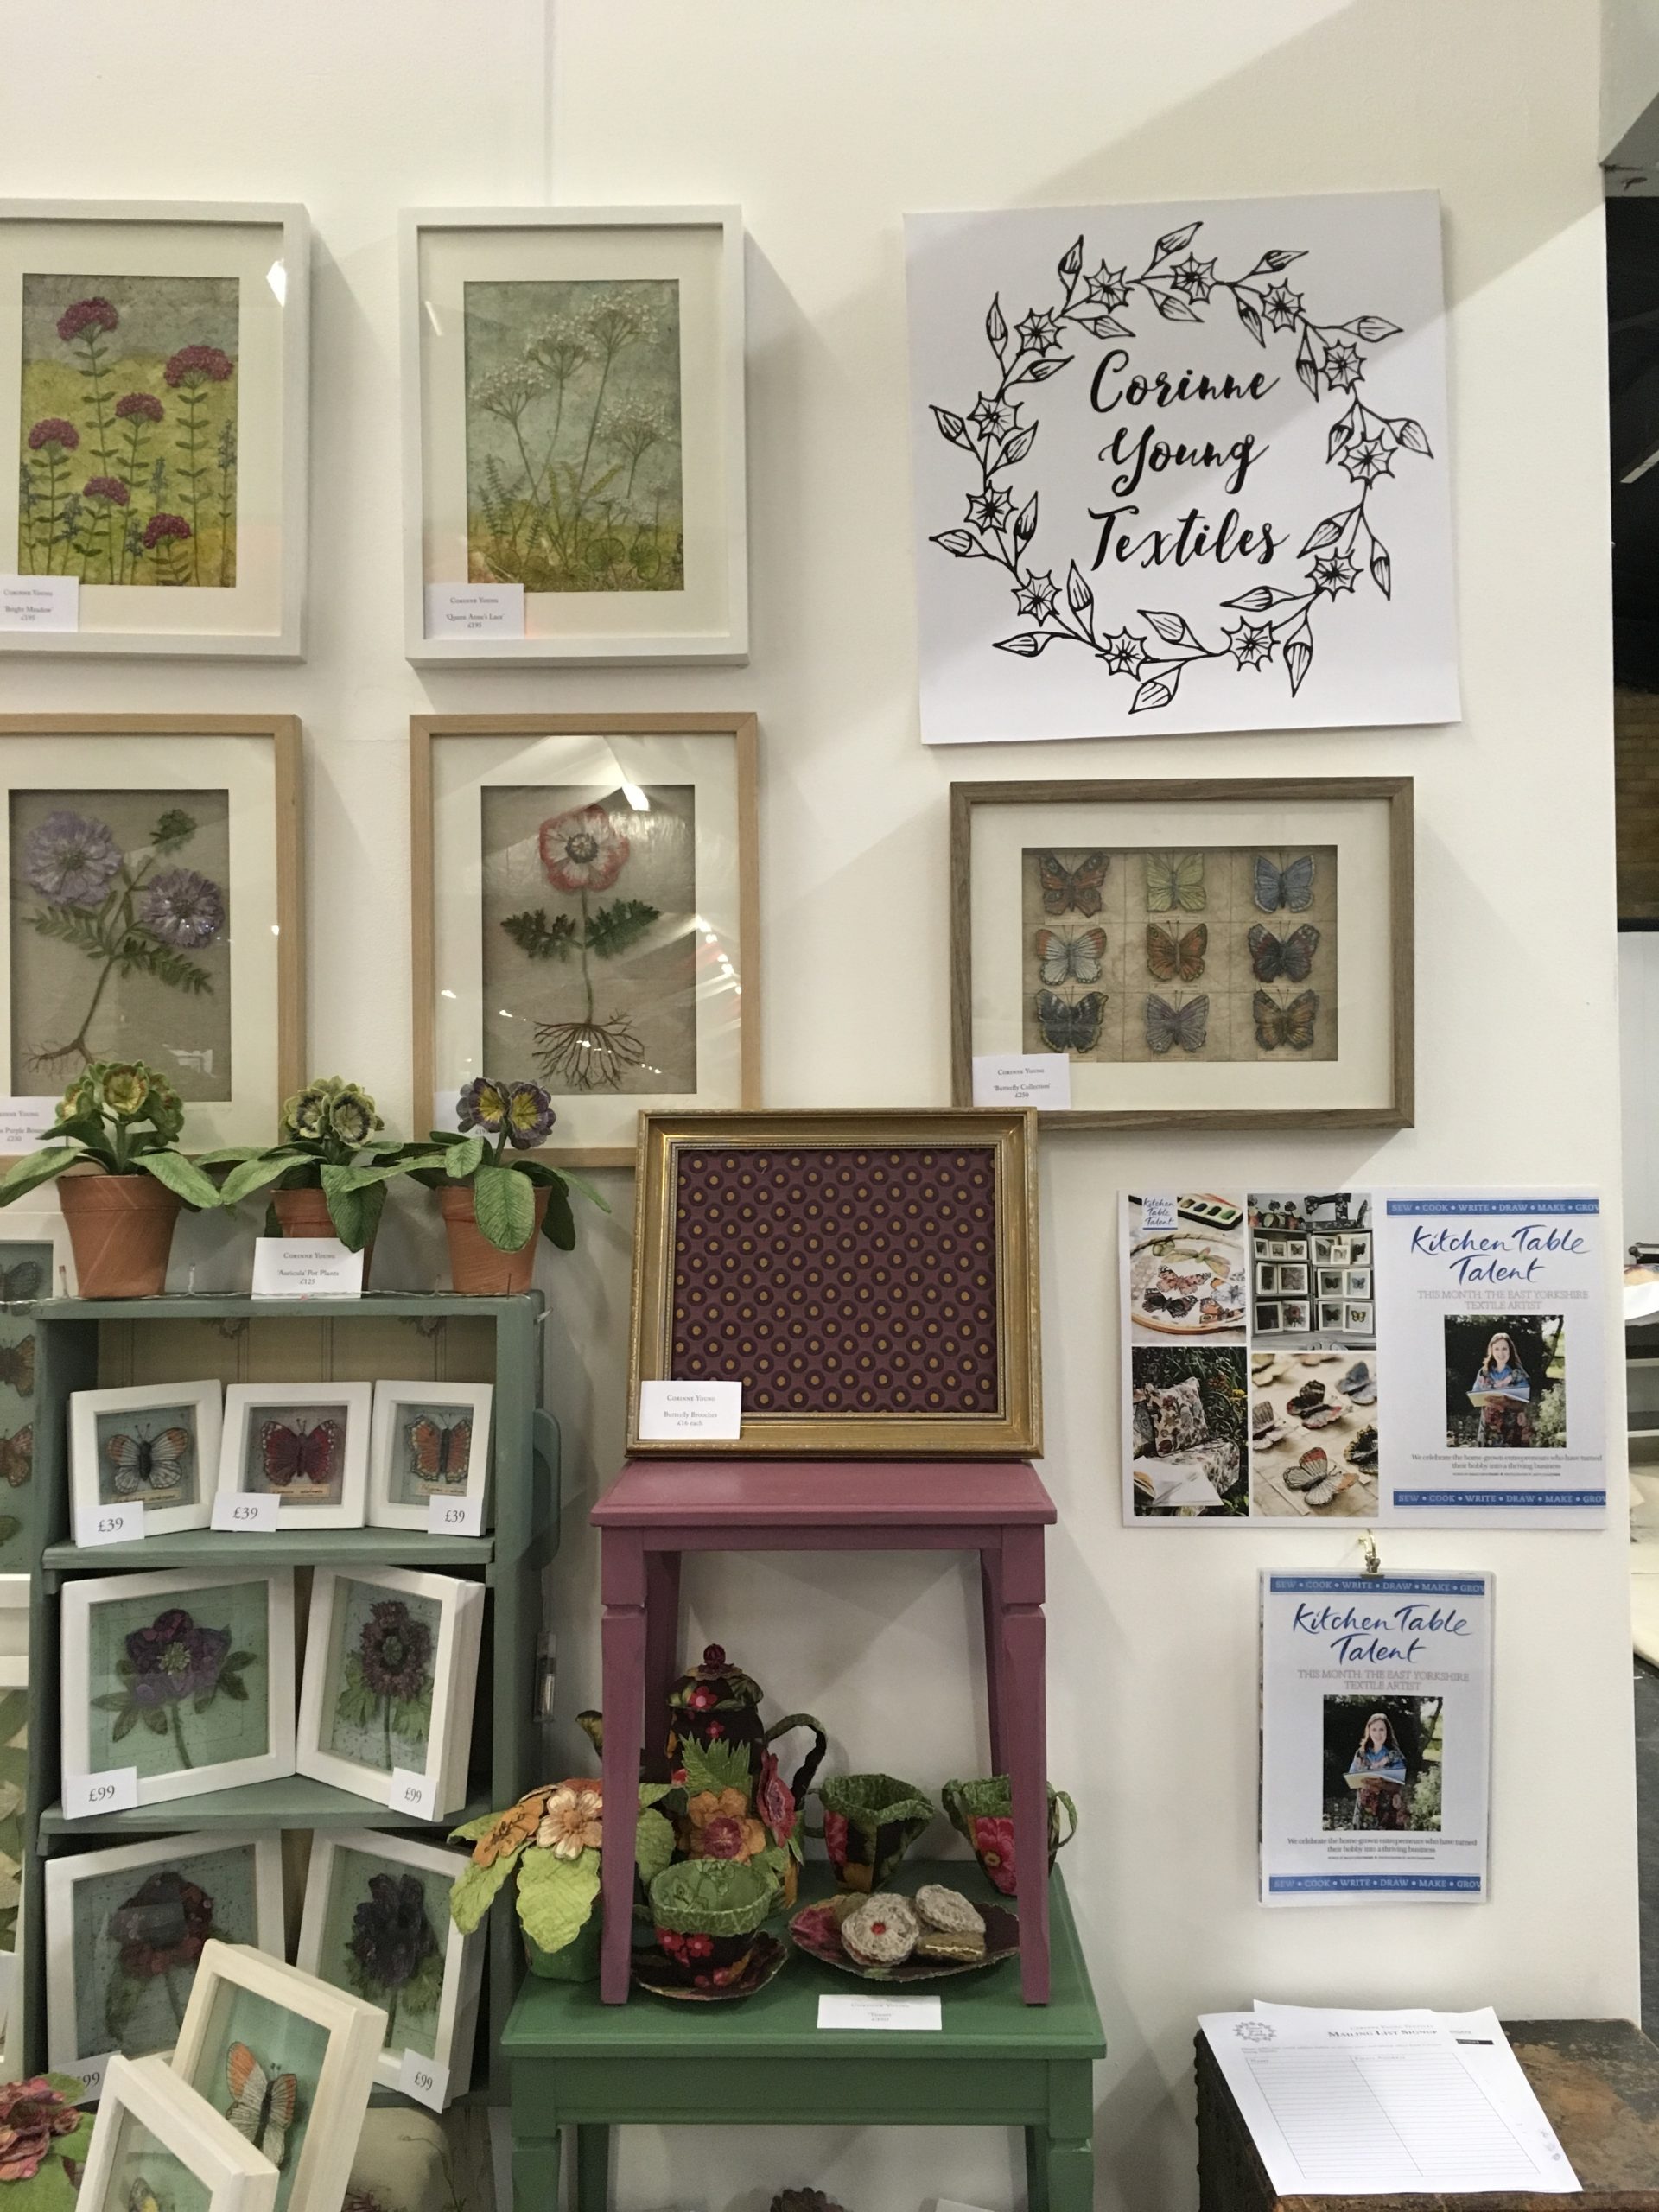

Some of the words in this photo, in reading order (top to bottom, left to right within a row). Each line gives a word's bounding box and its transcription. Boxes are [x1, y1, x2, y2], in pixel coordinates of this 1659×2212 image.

[1090, 349, 1281, 413] Corinne
[1097, 424, 1270, 498] Young
[1087, 508, 1290, 571] Textiles
[1147, 1206, 1171, 1216] Table
[1392, 1204, 1413, 1212] SEW
[1422, 1204, 1449, 1212] COOK
[1458, 1204, 1490, 1212] WRITE
[1499, 1204, 1529, 1212] DRAW
[1144, 1216, 1175, 1226] Talent
[1410, 1225, 1513, 1256] Kitchen
[1511, 1224, 1592, 1255] Table
[1449, 1254, 1546, 1286] Talent
[1417, 1290, 1440, 1300] THIS
[1485, 1290, 1505, 1300] THE
[1507, 1290, 1533, 1300] EAST
[1534, 1290, 1589, 1300] YORKSHIRE
[1465, 1301, 1506, 1310] TEXTILE
[1507, 1301, 1542, 1310] ARTIST
[232, 1506, 258, 1520] £39
[445, 1510, 466, 1523] £39
[97, 1517, 124, 1532] £39
[1421, 1583, 1450, 1592] MAKE
[1293, 1602, 1395, 1635] Kitchen
[1394, 1604, 1471, 1636] Table
[1330, 1632, 1427, 1665] Talent
[1298, 1669, 1321, 1679] THIS
[1364, 1669, 1385, 1680] THE
[1387, 1670, 1411, 1680] EAST
[1413, 1671, 1469, 1681] YORKSHIRE
[1344, 1681, 1384, 1690] TEXTILE
[1386, 1681, 1421, 1691] ARTIST
[88, 1784, 116, 1802] £99
[404, 1786, 423, 1804] £99
[1340, 1879, 1371, 1888] WRITE
[414, 2071, 434, 2091] £99
